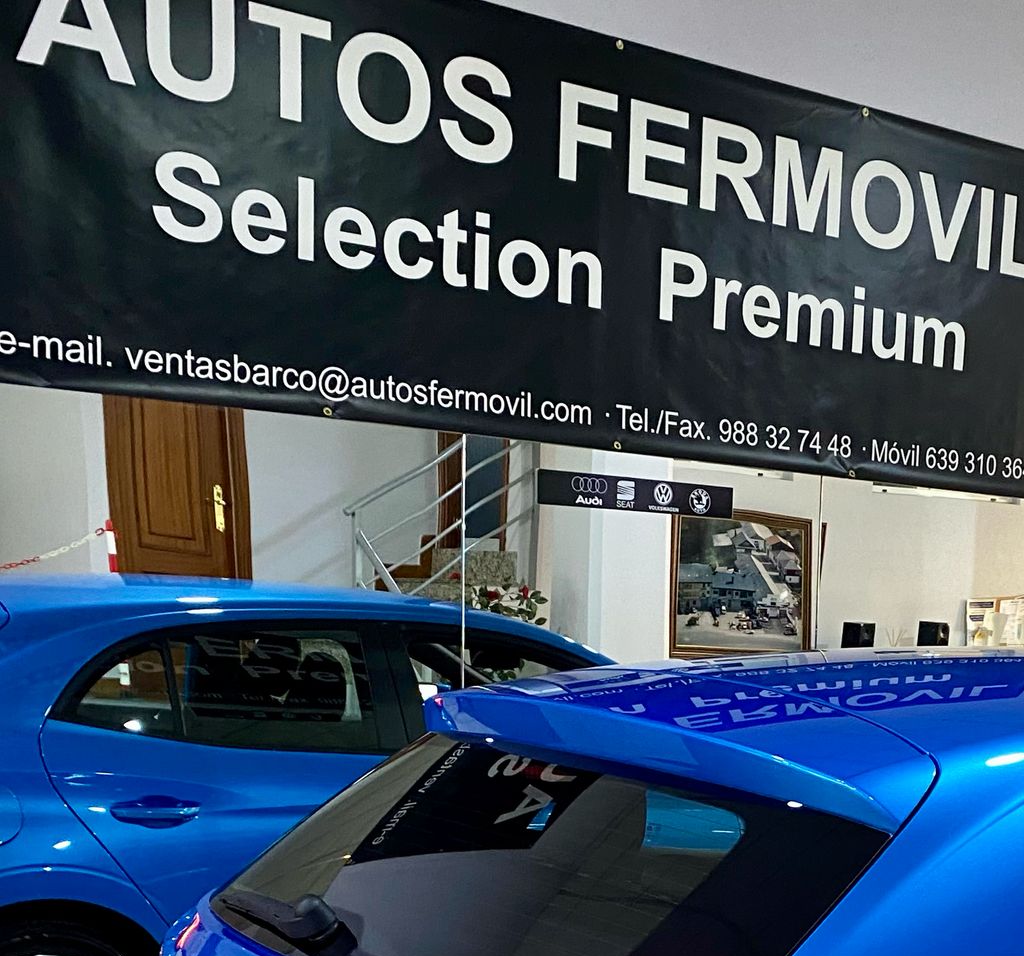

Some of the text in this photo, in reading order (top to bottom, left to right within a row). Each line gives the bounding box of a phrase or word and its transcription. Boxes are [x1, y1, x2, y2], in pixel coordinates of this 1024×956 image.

[16, 0, 514, 164] AUTOS
[152, 150, 966, 372] Selection Premium
[0, 330, 113, 368] e-mail.
[125, 346, 592, 426] ventasbarco@autosfermovil.com
[615, 403, 711, 441] Tel./Fax.
[719, 418, 759, 447] 988
[765, 424, 791, 451] 32
[797, 429, 822, 455] 74
[827, 433, 852, 459] 48
[871, 438, 920, 467] Móvil
[925, 446, 959, 472] 639
[964, 451, 997, 477] 310
[575, 494, 603, 506] Audi
[616, 500, 635, 509] SEAT
